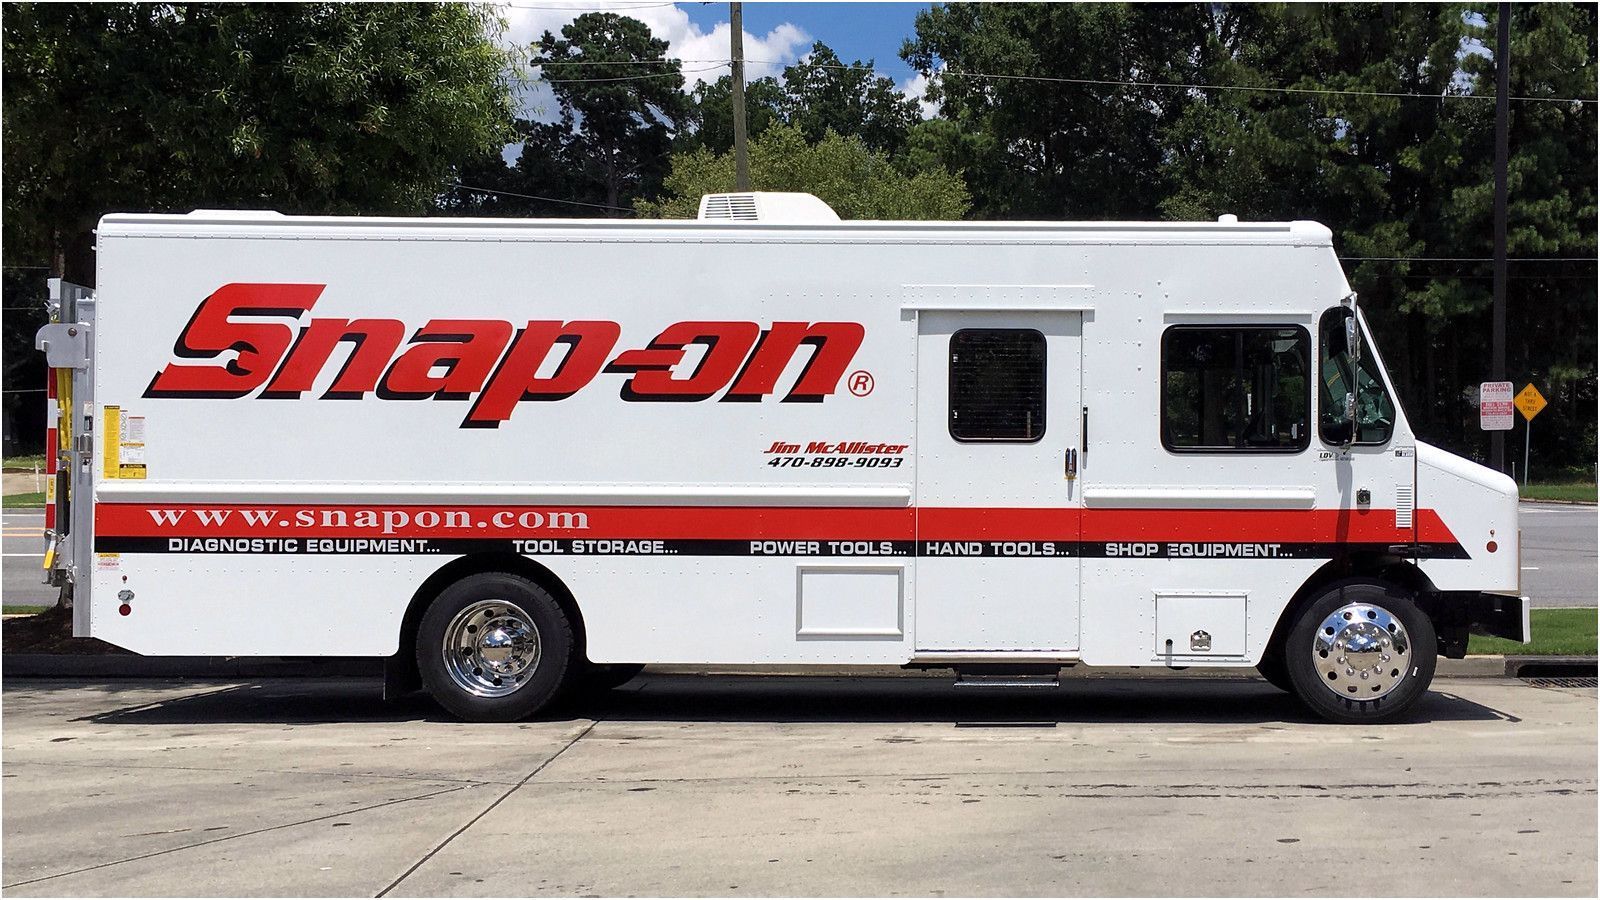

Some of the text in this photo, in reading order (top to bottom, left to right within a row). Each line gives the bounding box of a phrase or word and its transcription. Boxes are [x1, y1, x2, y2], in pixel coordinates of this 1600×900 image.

[142, 283, 866, 429] Snap-on
[763, 441, 909, 454] Jim McAllister
[767, 457, 904, 468] 470-898-9093
[146, 508, 590, 534] www.snapon.com
[168, 538, 441, 554] DIAGNOSTIC EQUIPMENT...
[512, 540, 679, 554] TOOL STORAGE...
[750, 541, 907, 555] POWER TOOLS...
[926, 542, 1070, 556] HAND TOOLS...
[1105, 542, 1159, 557] SHOP
